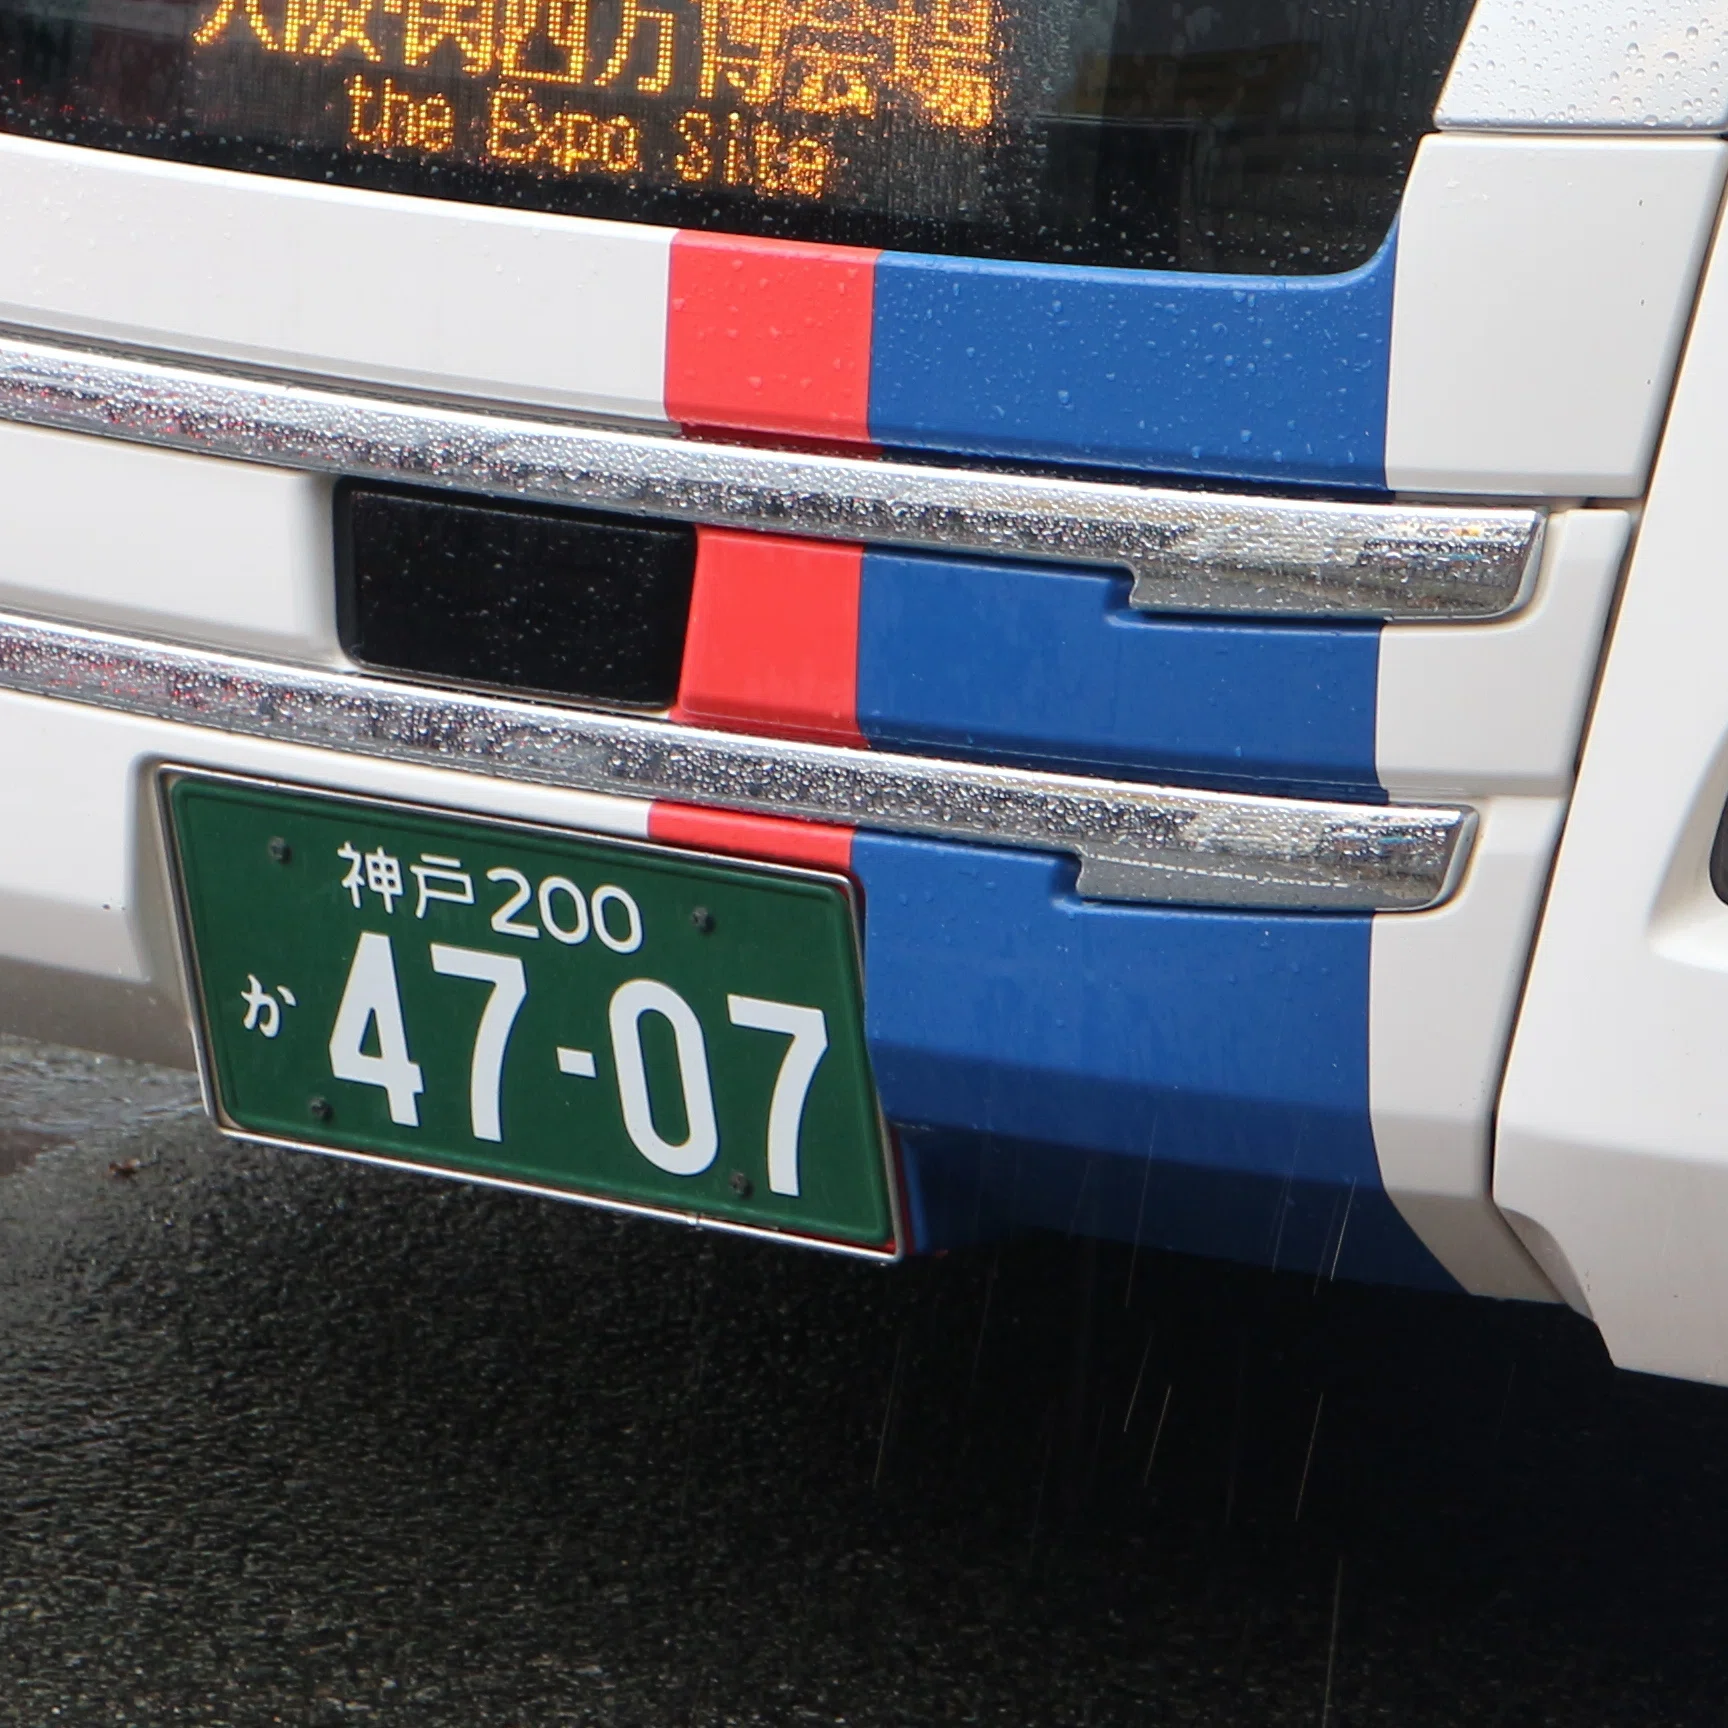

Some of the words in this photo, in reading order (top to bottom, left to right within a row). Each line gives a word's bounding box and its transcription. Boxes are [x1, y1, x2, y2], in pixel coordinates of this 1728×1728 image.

[345, 74, 455, 153] the
[488, 84, 640, 174] Expo
[674, 111, 828, 200] Site
[241, 974, 296, 1038] か
[329, 931, 828, 1197] 47-07
